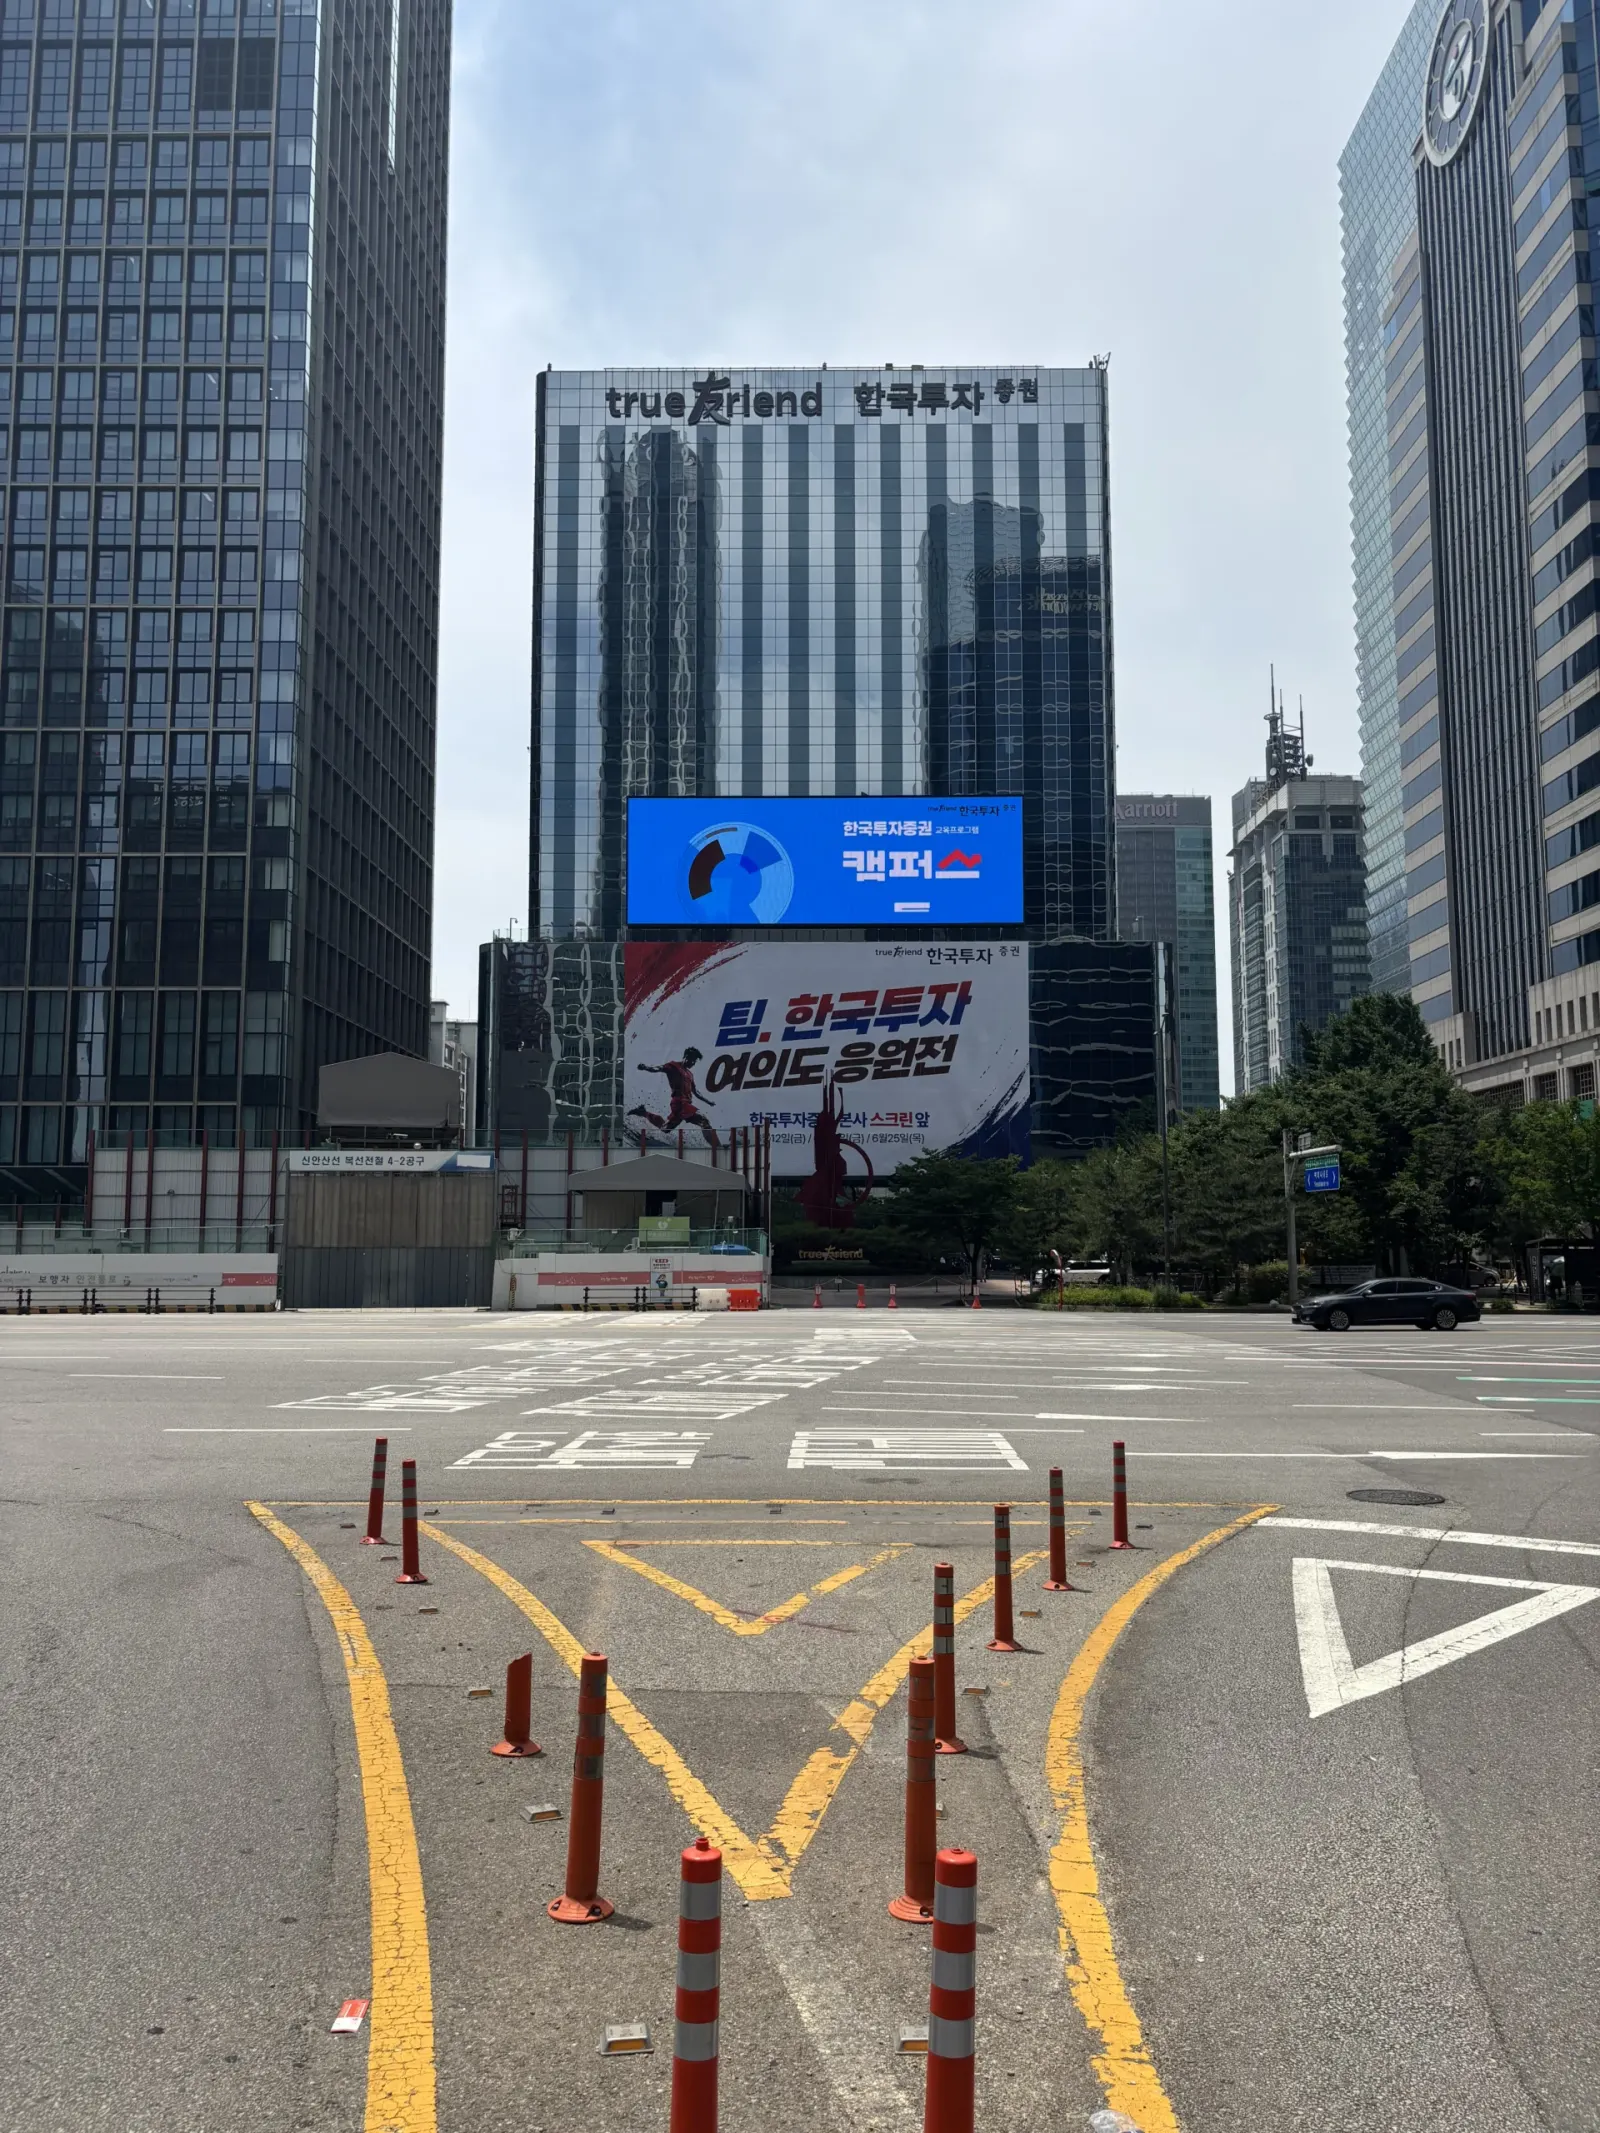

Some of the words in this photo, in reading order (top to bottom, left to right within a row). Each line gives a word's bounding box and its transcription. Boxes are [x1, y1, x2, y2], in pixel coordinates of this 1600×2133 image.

[853, 381, 985, 417] 한국투자
[993, 377, 1040, 403] 증권
[843, 820, 933, 837] 한국투자증권
[935, 826, 980, 835] 교육프로그램
[926, 947, 994, 965] 한국투자
[998, 945, 1021, 957] 증권
[714, 998, 772, 1048] 팀.
[781, 980, 973, 1042] 한국투자
[704, 1046, 830, 1094] 여의도
[832, 1033, 959, 1085] 응원전
[749, 1111, 820, 1129] 한국투자증
[838, 1111, 868, 1129] 본사
[869, 1111, 914, 1128] 스크린
[914, 1111, 930, 1129] 앞
[871, 1132, 925, 1145] 6월25일(목)
[301, 1155, 341, 1167] 신안산선
[387, 1155, 425, 1167] 4-2공구
[38, 1274, 71, 1285] 보행자
[443, 1430, 715, 1470] 환승센터
[784, 1431, 1031, 1471] 마포대교
